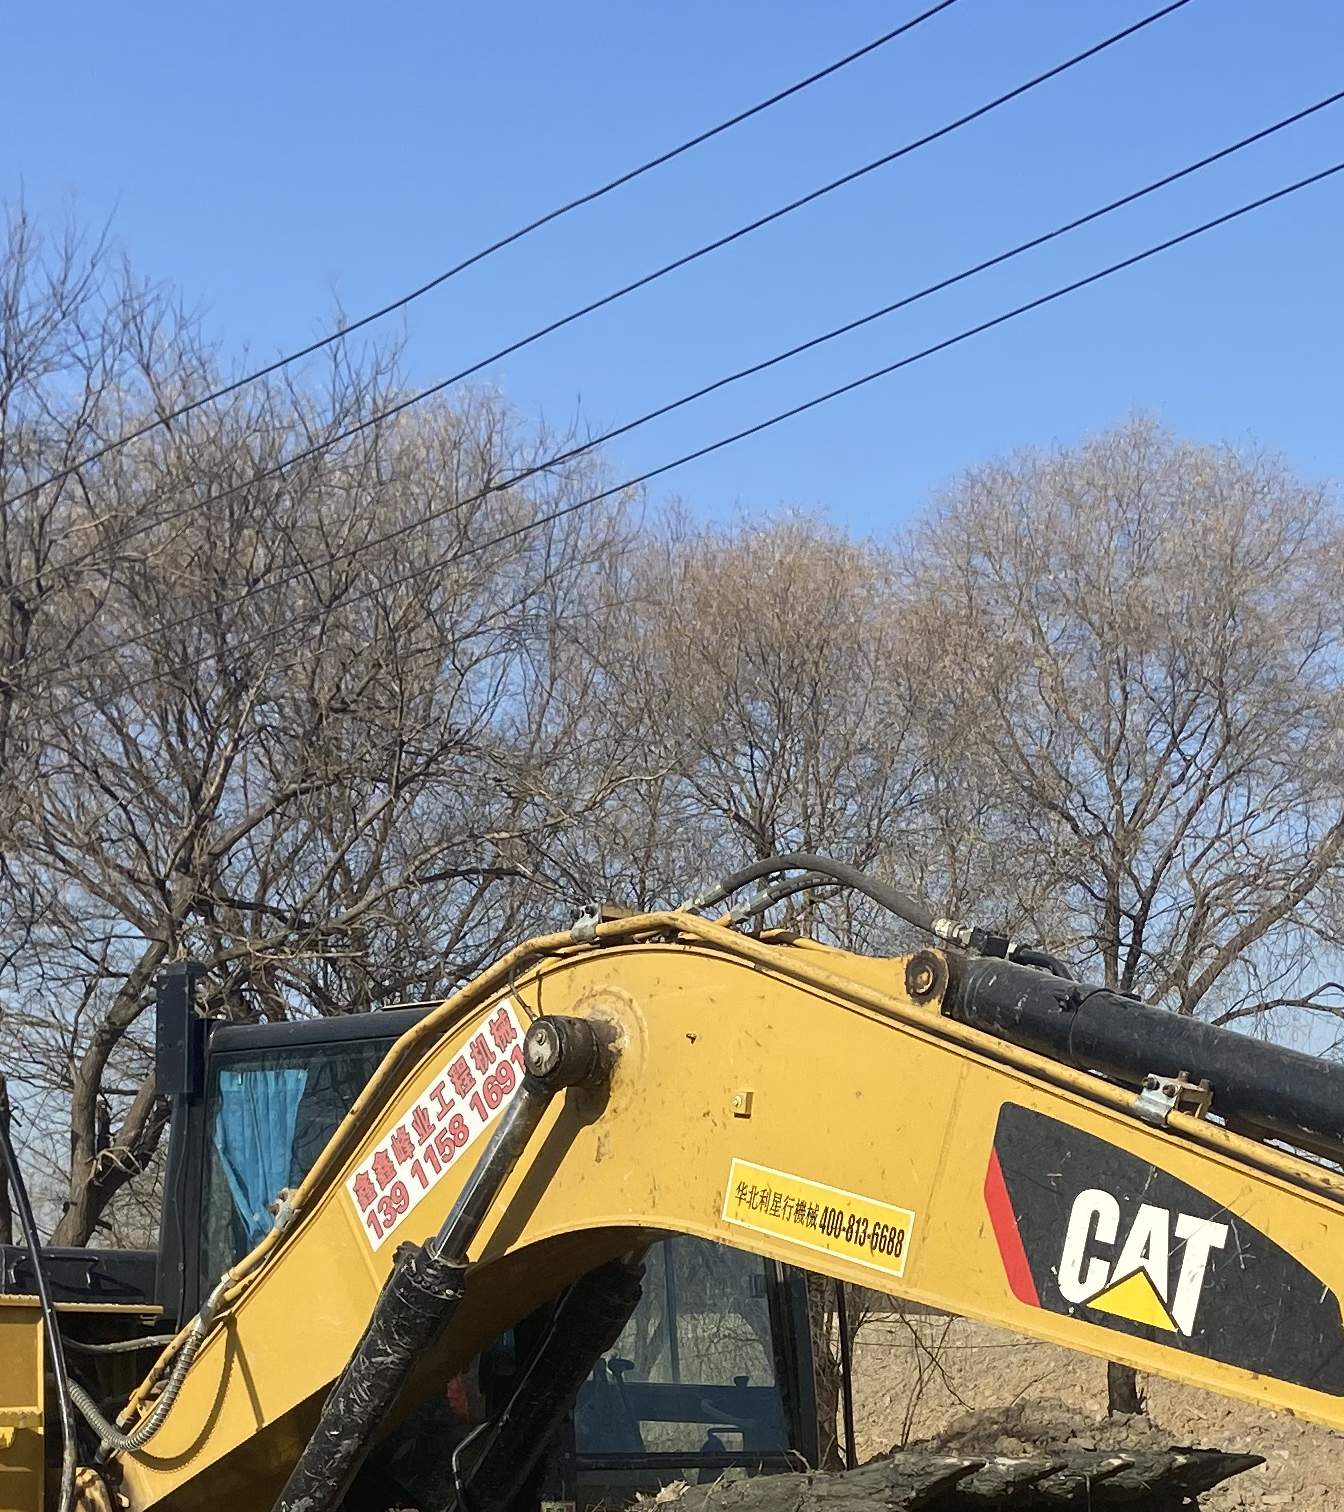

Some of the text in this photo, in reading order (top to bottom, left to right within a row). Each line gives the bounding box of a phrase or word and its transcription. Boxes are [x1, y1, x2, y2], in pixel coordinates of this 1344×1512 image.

[367, 1181, 409, 1239] 139
[411, 1114, 469, 1189] 1158
[819, 1206, 904, 1258] 400-813-6688
[1058, 1188, 1228, 1337] CAT
